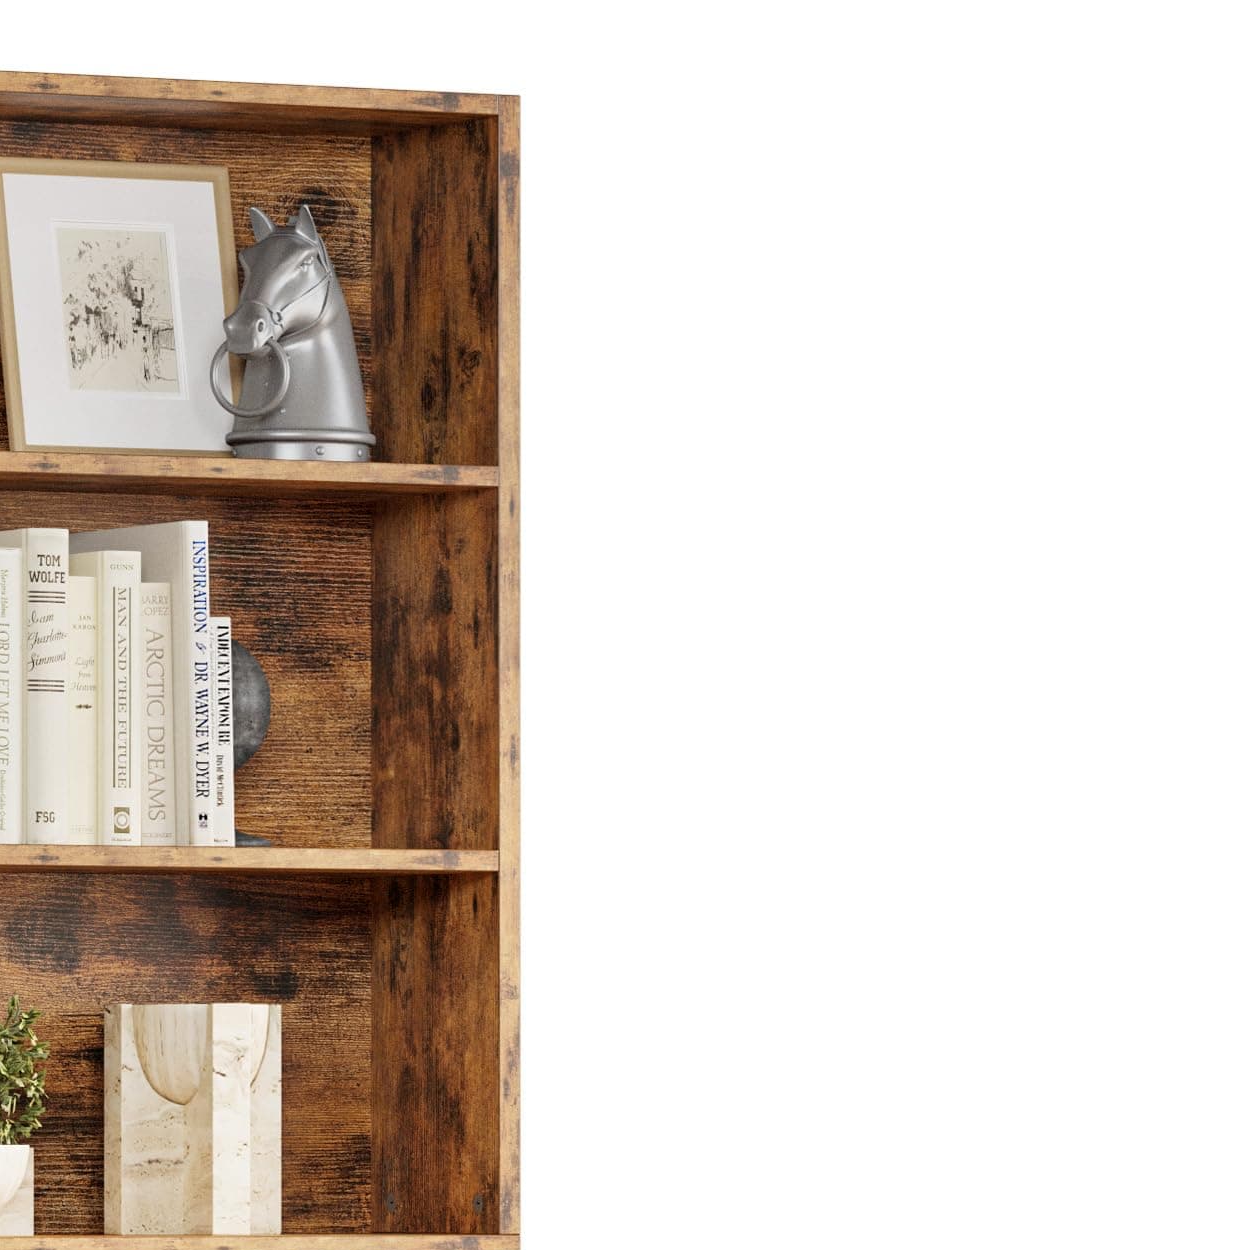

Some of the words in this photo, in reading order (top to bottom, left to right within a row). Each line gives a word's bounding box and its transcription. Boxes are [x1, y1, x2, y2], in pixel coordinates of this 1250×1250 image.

[29, 571, 65, 583] WOLFE
[37, 554, 61, 567] TOM
[110, 563, 134, 571] GUNN
[192, 540, 207, 634] INSPIRATION
[117, 587, 127, 628] MAN
[117, 633, 127, 671] AND
[217, 625, 230, 684] INDECENT
[146, 627, 165, 717] ARCTIC
[194, 662, 208, 684] DR.
[117, 676, 127, 713] THE
[195, 688, 209, 737] WAYNE
[217, 687, 231, 746] EXPOSURE
[117, 720, 127, 789] FUTURE
[195, 741, 209, 757] W.
[147, 726, 166, 821] DREAMS
[195, 761, 210, 798] DYER
[35, 811, 55, 823] FSG
